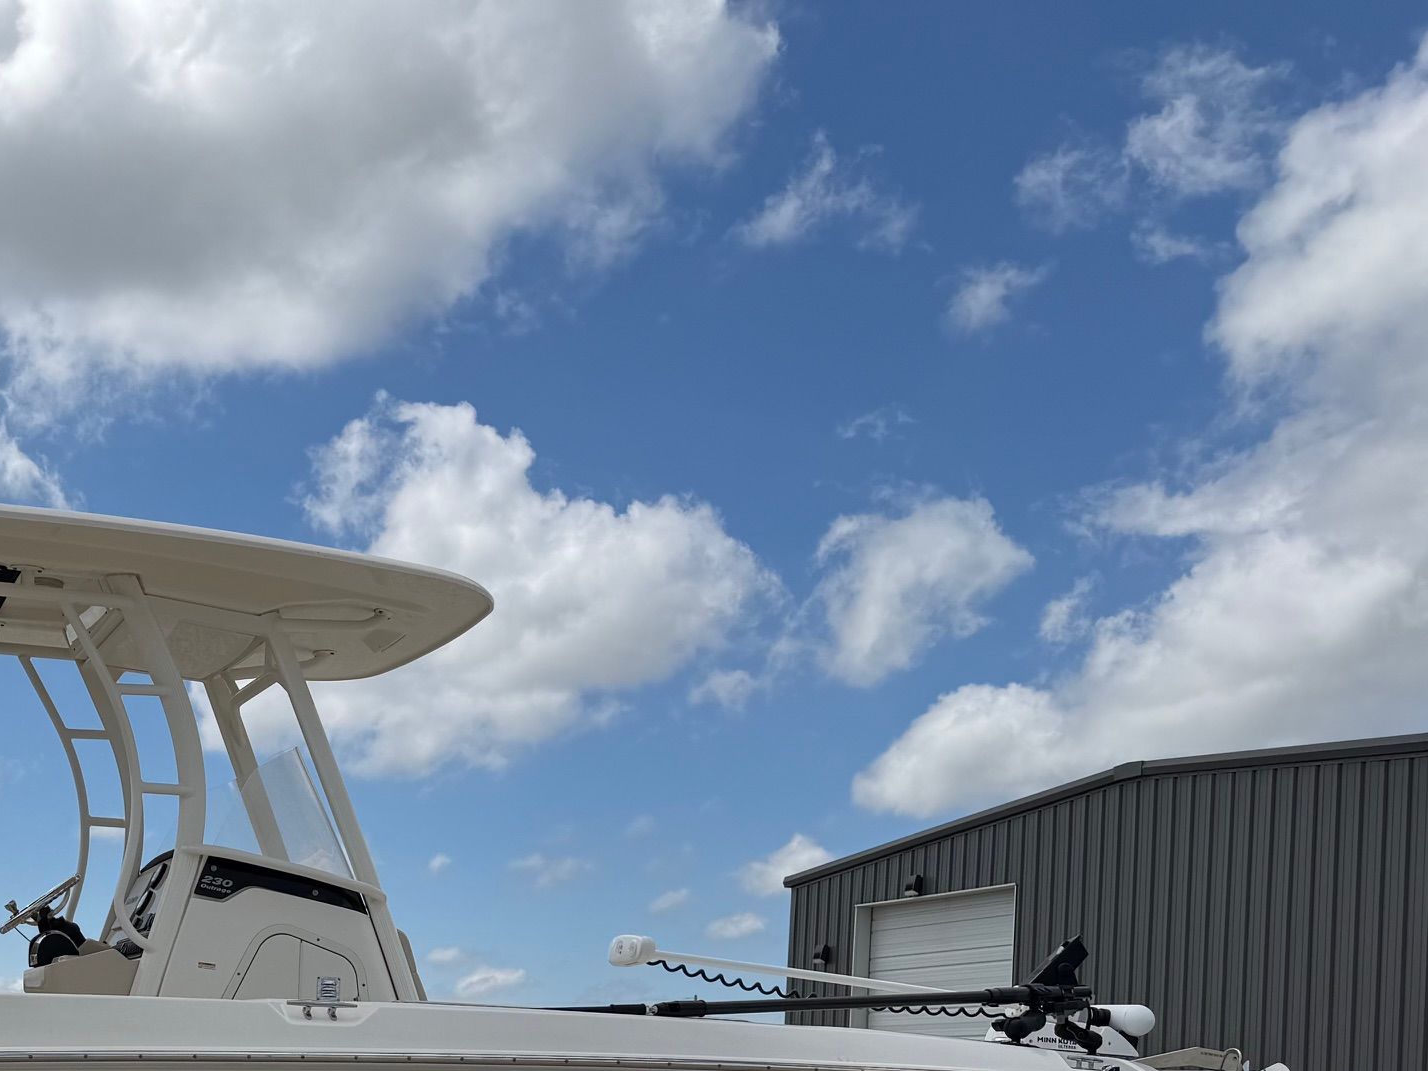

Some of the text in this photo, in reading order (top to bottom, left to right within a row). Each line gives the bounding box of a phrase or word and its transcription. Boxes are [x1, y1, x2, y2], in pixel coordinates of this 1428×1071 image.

[200, 875, 234, 888] 230
[200, 883, 232, 894] Outrage
[1037, 1036, 1057, 1044] MINN
